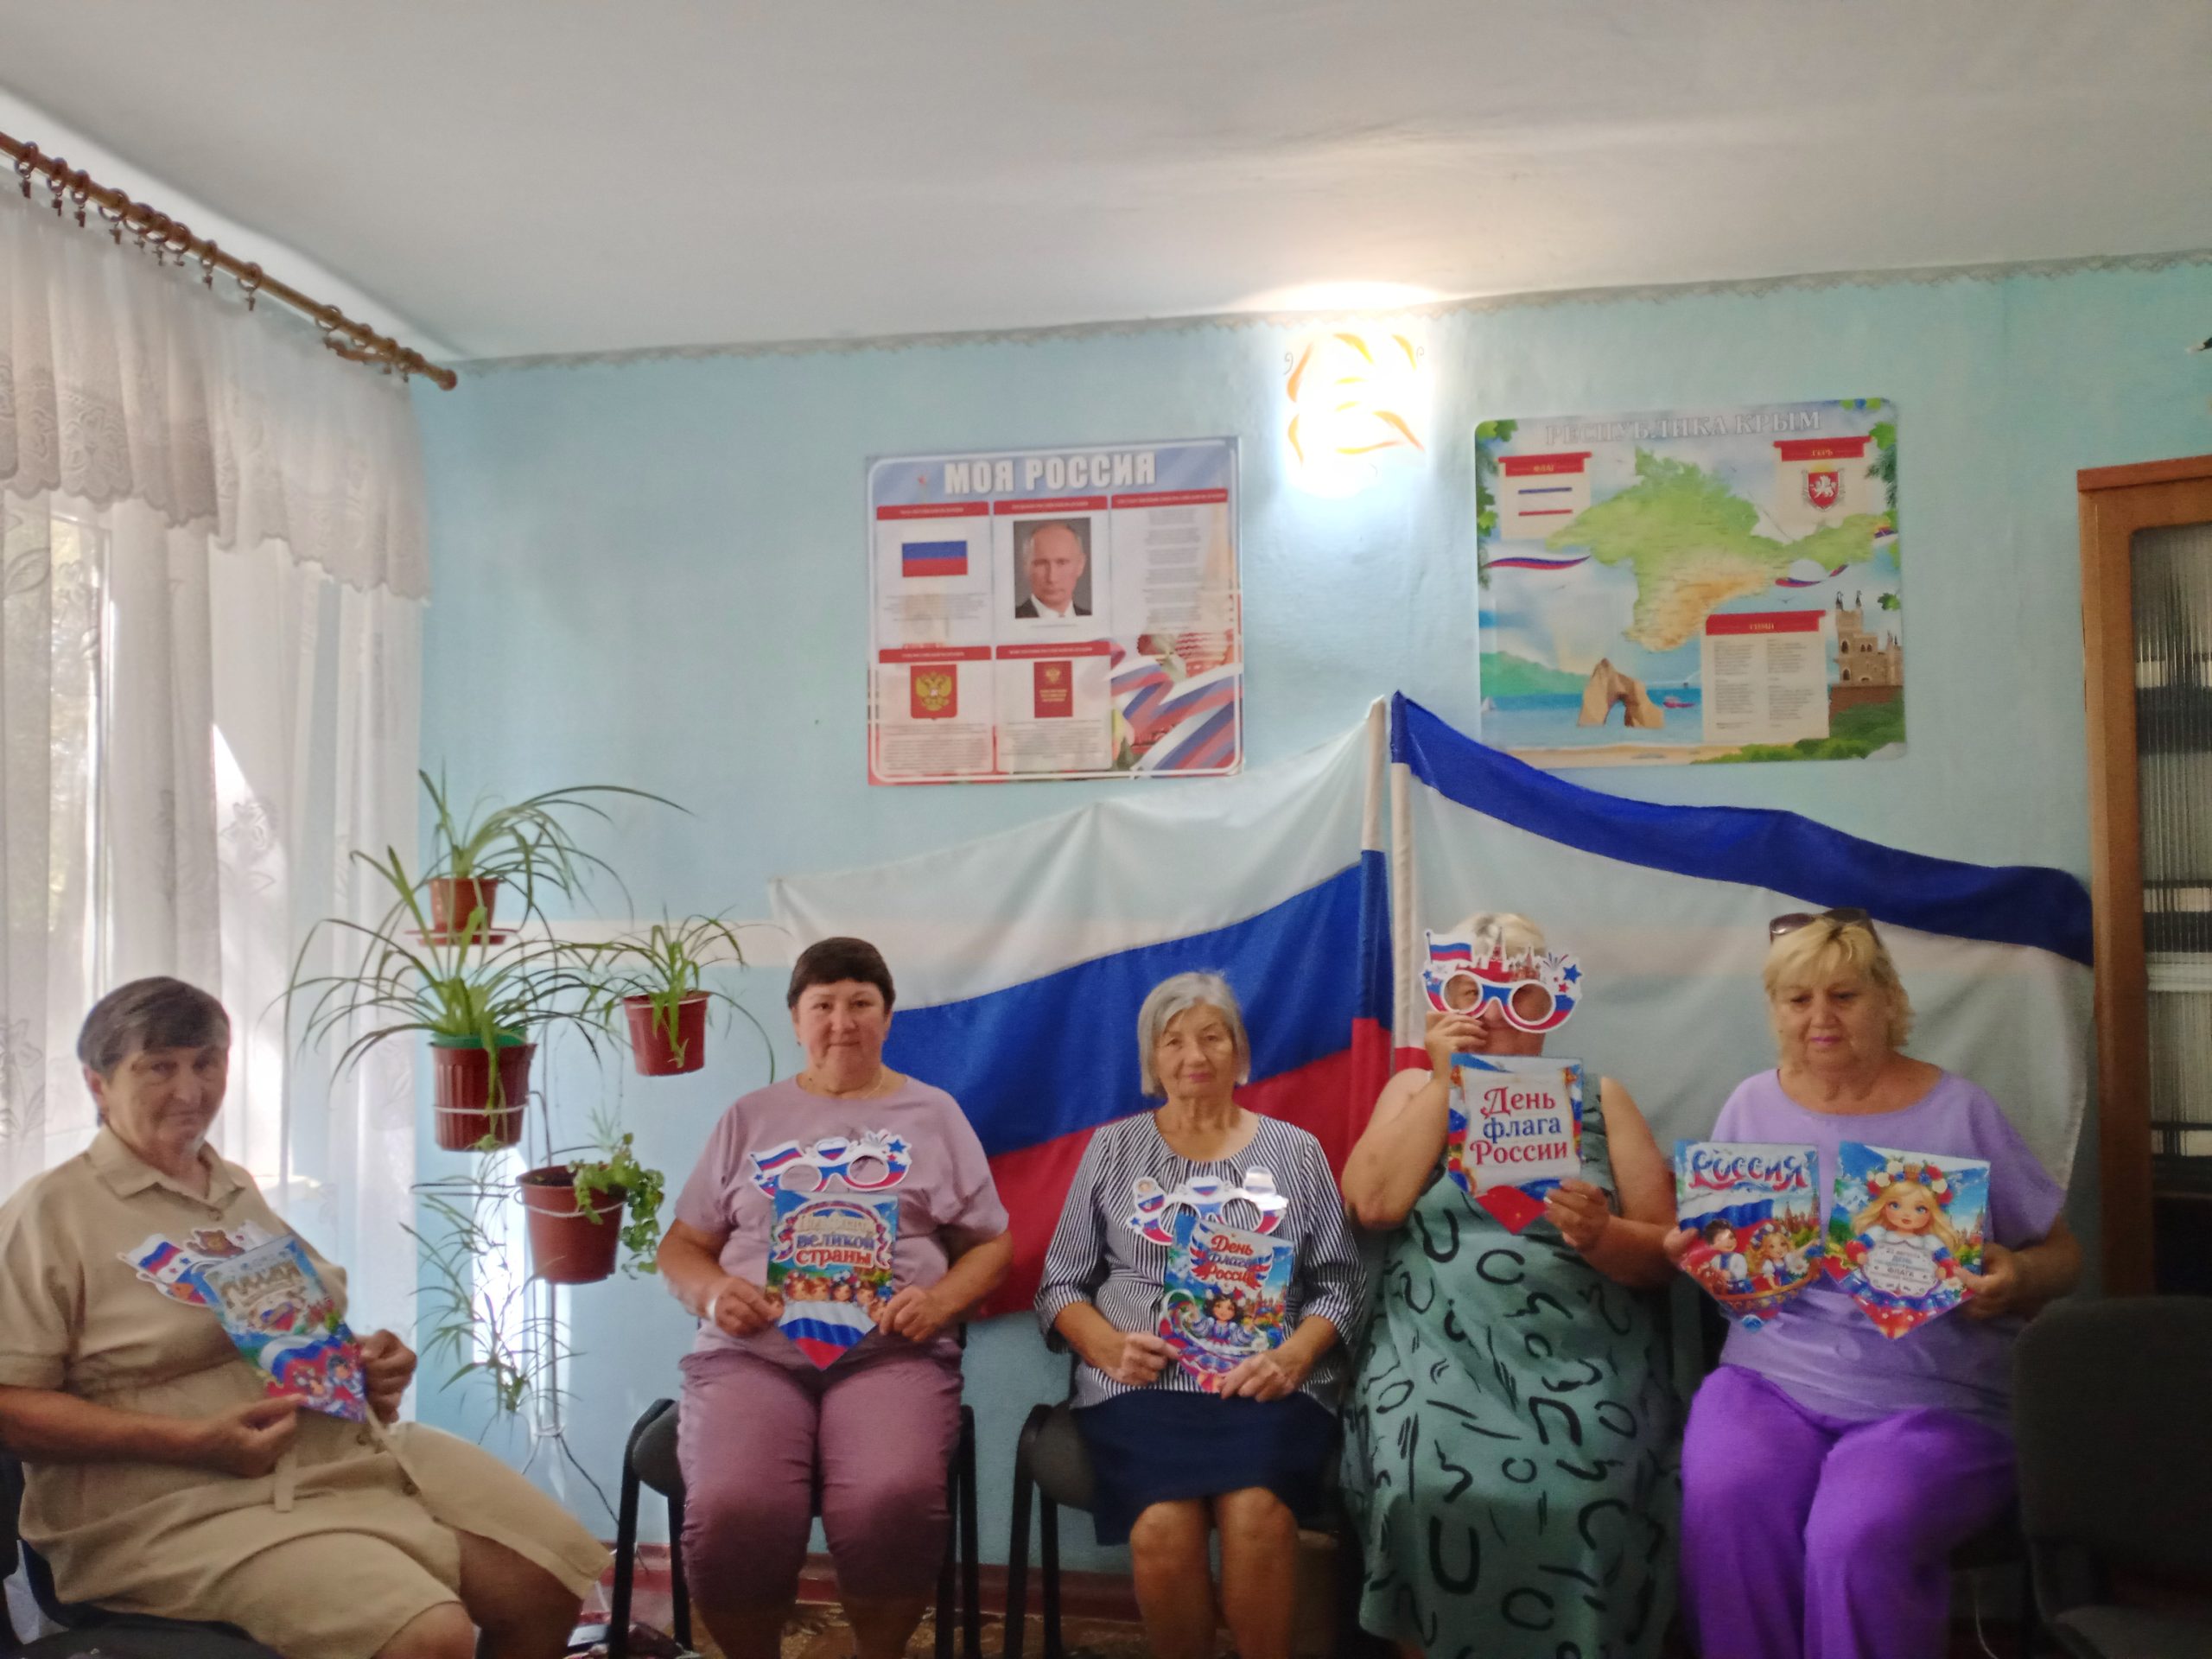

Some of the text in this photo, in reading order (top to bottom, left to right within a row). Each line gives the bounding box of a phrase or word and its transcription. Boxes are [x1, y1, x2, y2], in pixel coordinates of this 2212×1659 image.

[1546, 410, 1821, 445] РЕСПУБЛИКА КРЫМ
[944, 451, 1156, 494] МОЯ РОССИЯ
[1480, 1086, 1556, 1120] День
[1483, 1117, 1561, 1144] флага
[1470, 1140, 1567, 1166] России
[1688, 1150, 1808, 1192] Россия
[796, 1249, 872, 1268] страны
[1211, 1234, 1254, 1256] День
